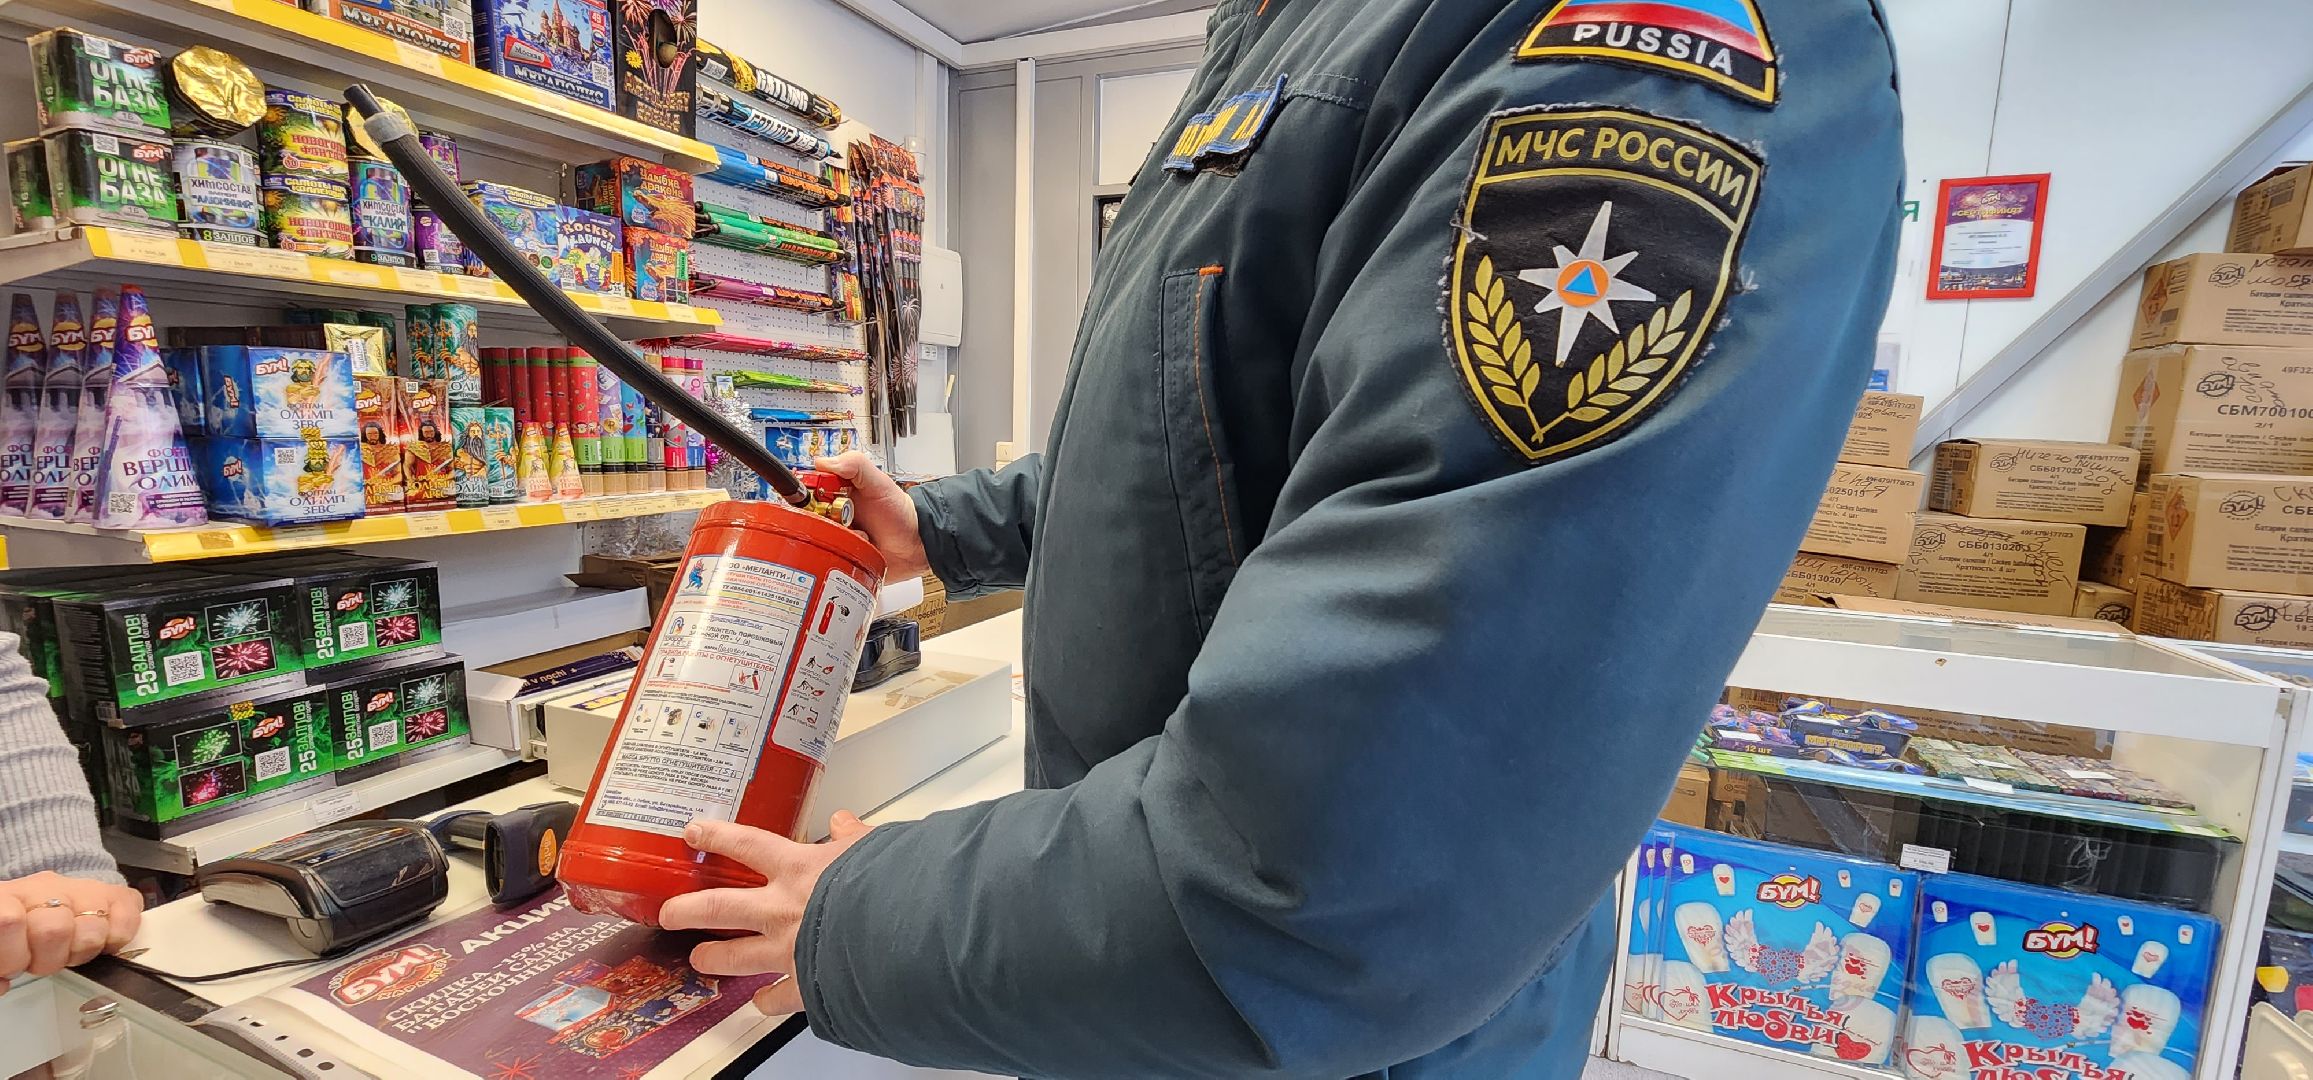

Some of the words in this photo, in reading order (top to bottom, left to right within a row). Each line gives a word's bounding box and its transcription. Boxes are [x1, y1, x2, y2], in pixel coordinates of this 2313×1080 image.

[93, 79, 159, 114] БАЗА
[1496, 126, 1580, 168] МЧС
[1591, 127, 1746, 206] РОССИИ
[100, 176, 167, 209] БАЗА
[203, 230, 212, 242] 8
[213, 231, 256, 245] ЗАЛПОВ
[562, 222, 616, 243] ROCKET
[570, 233, 614, 252] LAUNCH
[371, 253, 378, 262] 9
[255, 356, 290, 377] БУМ!
[412, 394, 436, 410] БУМ!
[280, 409, 334, 420] ОЛИМП
[293, 420, 324, 431] ЗЕВС
[223, 458, 243, 479] БУМ!
[290, 495, 346, 507] ОЛИМП
[1824, 487, 1866, 498] 025019
[303, 504, 336, 515] ЗЕВС
[2219, 495, 2266, 514] БУМ!
[310, 587, 329, 639] ЗАЛПОВ!
[336, 592, 364, 611] БУМ!
[2235, 605, 2277, 627] БУМ!
[160, 616, 197, 640] БУМ!
[124, 613, 151, 673] ЗАЛПОВ!
[316, 636, 335, 660] 25
[135, 670, 160, 698] 25
[367, 691, 395, 713] БУМ!
[293, 700, 311, 753] ЗАЛПОВ!
[341, 690, 359, 740] ЗАЛПОВ!
[252, 715, 285, 739] БУМ!
[347, 737, 364, 761] 25
[1744, 744, 1757, 753] 12
[300, 750, 317, 773] 25
[1758, 877, 1820, 903] БУМ!
[2025, 927, 2097, 952] БУМ!
[341, 947, 438, 1001] БУМ!
[384, 971, 490, 1023] СКИДКА
[546, 925, 580, 945] НА
[392, 968, 512, 1033] БАТАРЕЙ
[509, 920, 613, 975] САЛЮТОВ
[1706, 983, 1849, 1029] Крылья
